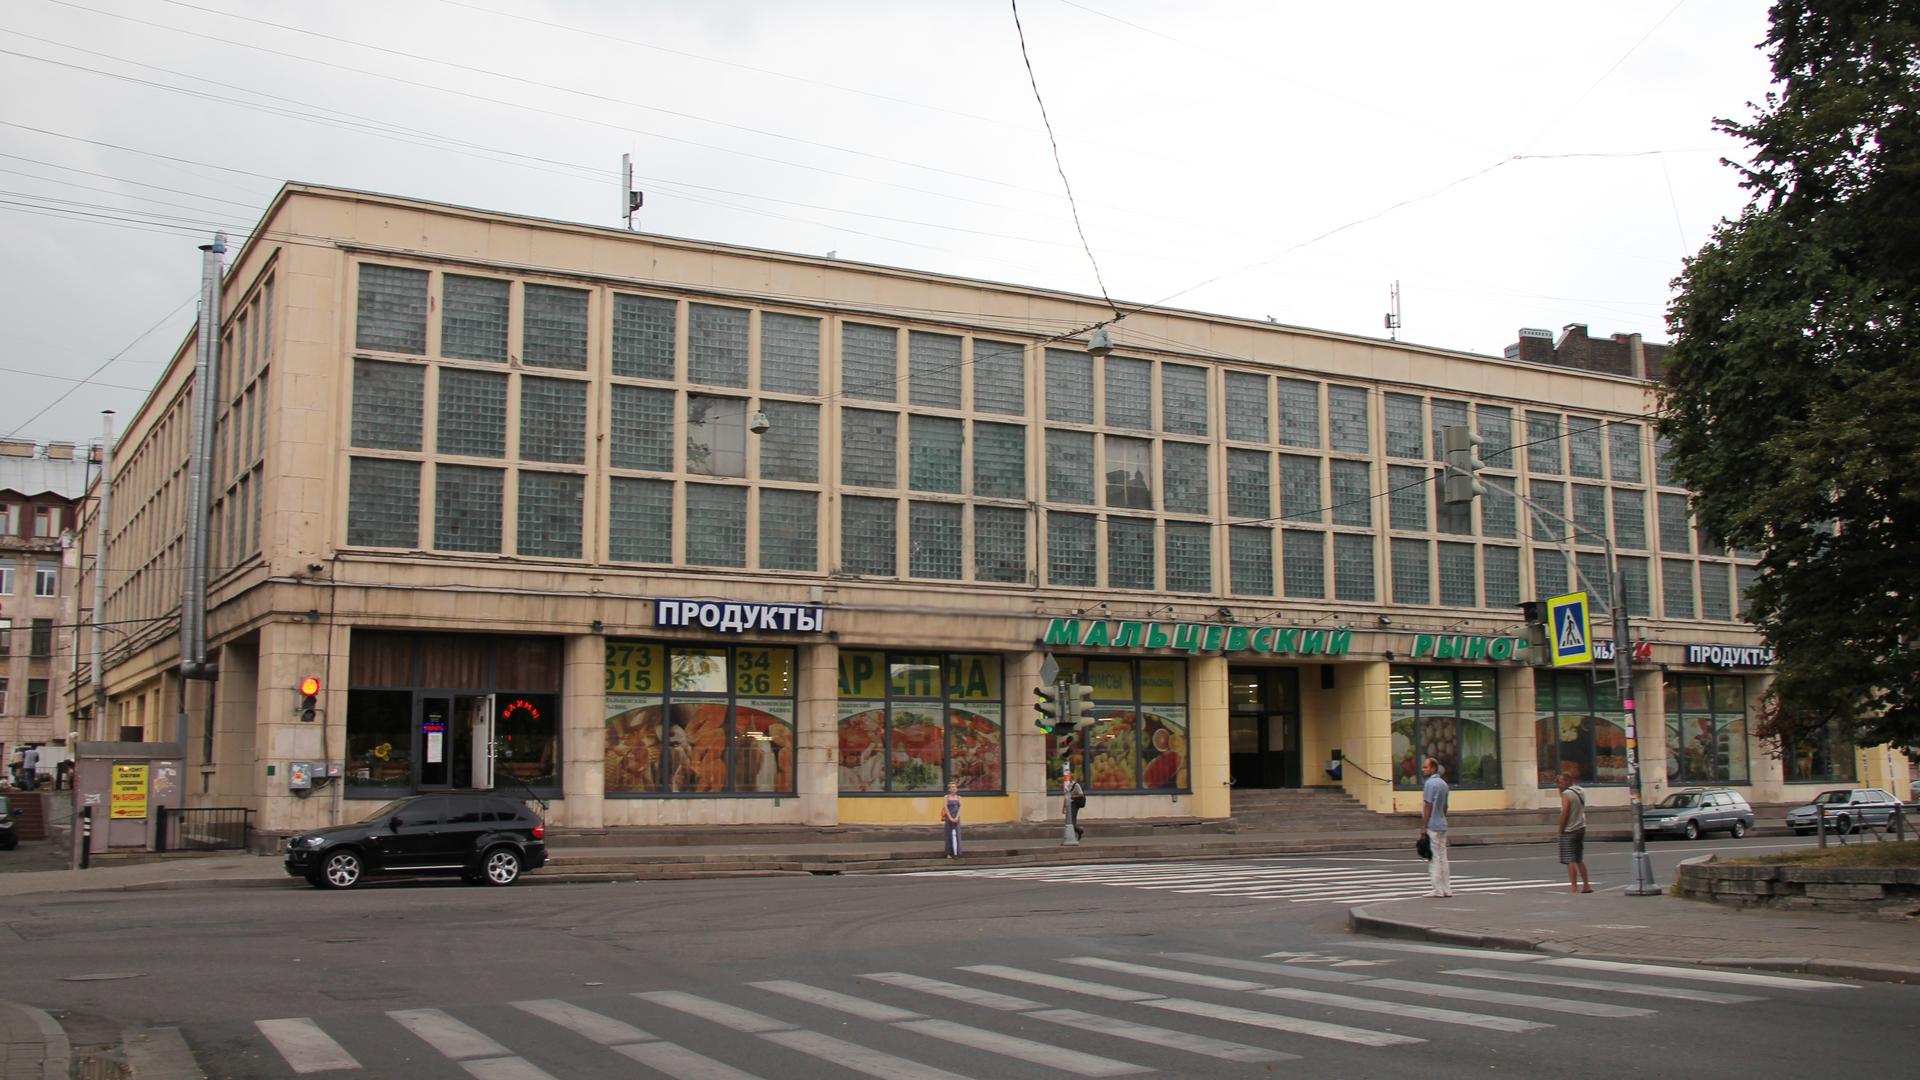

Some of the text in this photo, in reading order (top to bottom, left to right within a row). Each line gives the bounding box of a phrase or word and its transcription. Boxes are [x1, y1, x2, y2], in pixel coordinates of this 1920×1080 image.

[658, 601, 822, 632] ПРОДУКТЫ
[1043, 618, 1352, 656] МАЛЬЦЕВСКИЙ
[606, 645, 652, 667] 273
[738, 651, 770, 671] 34
[1633, 642, 1651, 657] 24
[1690, 646, 1774, 668] ПРОДУКТЫ
[738, 673, 770, 694] 36
